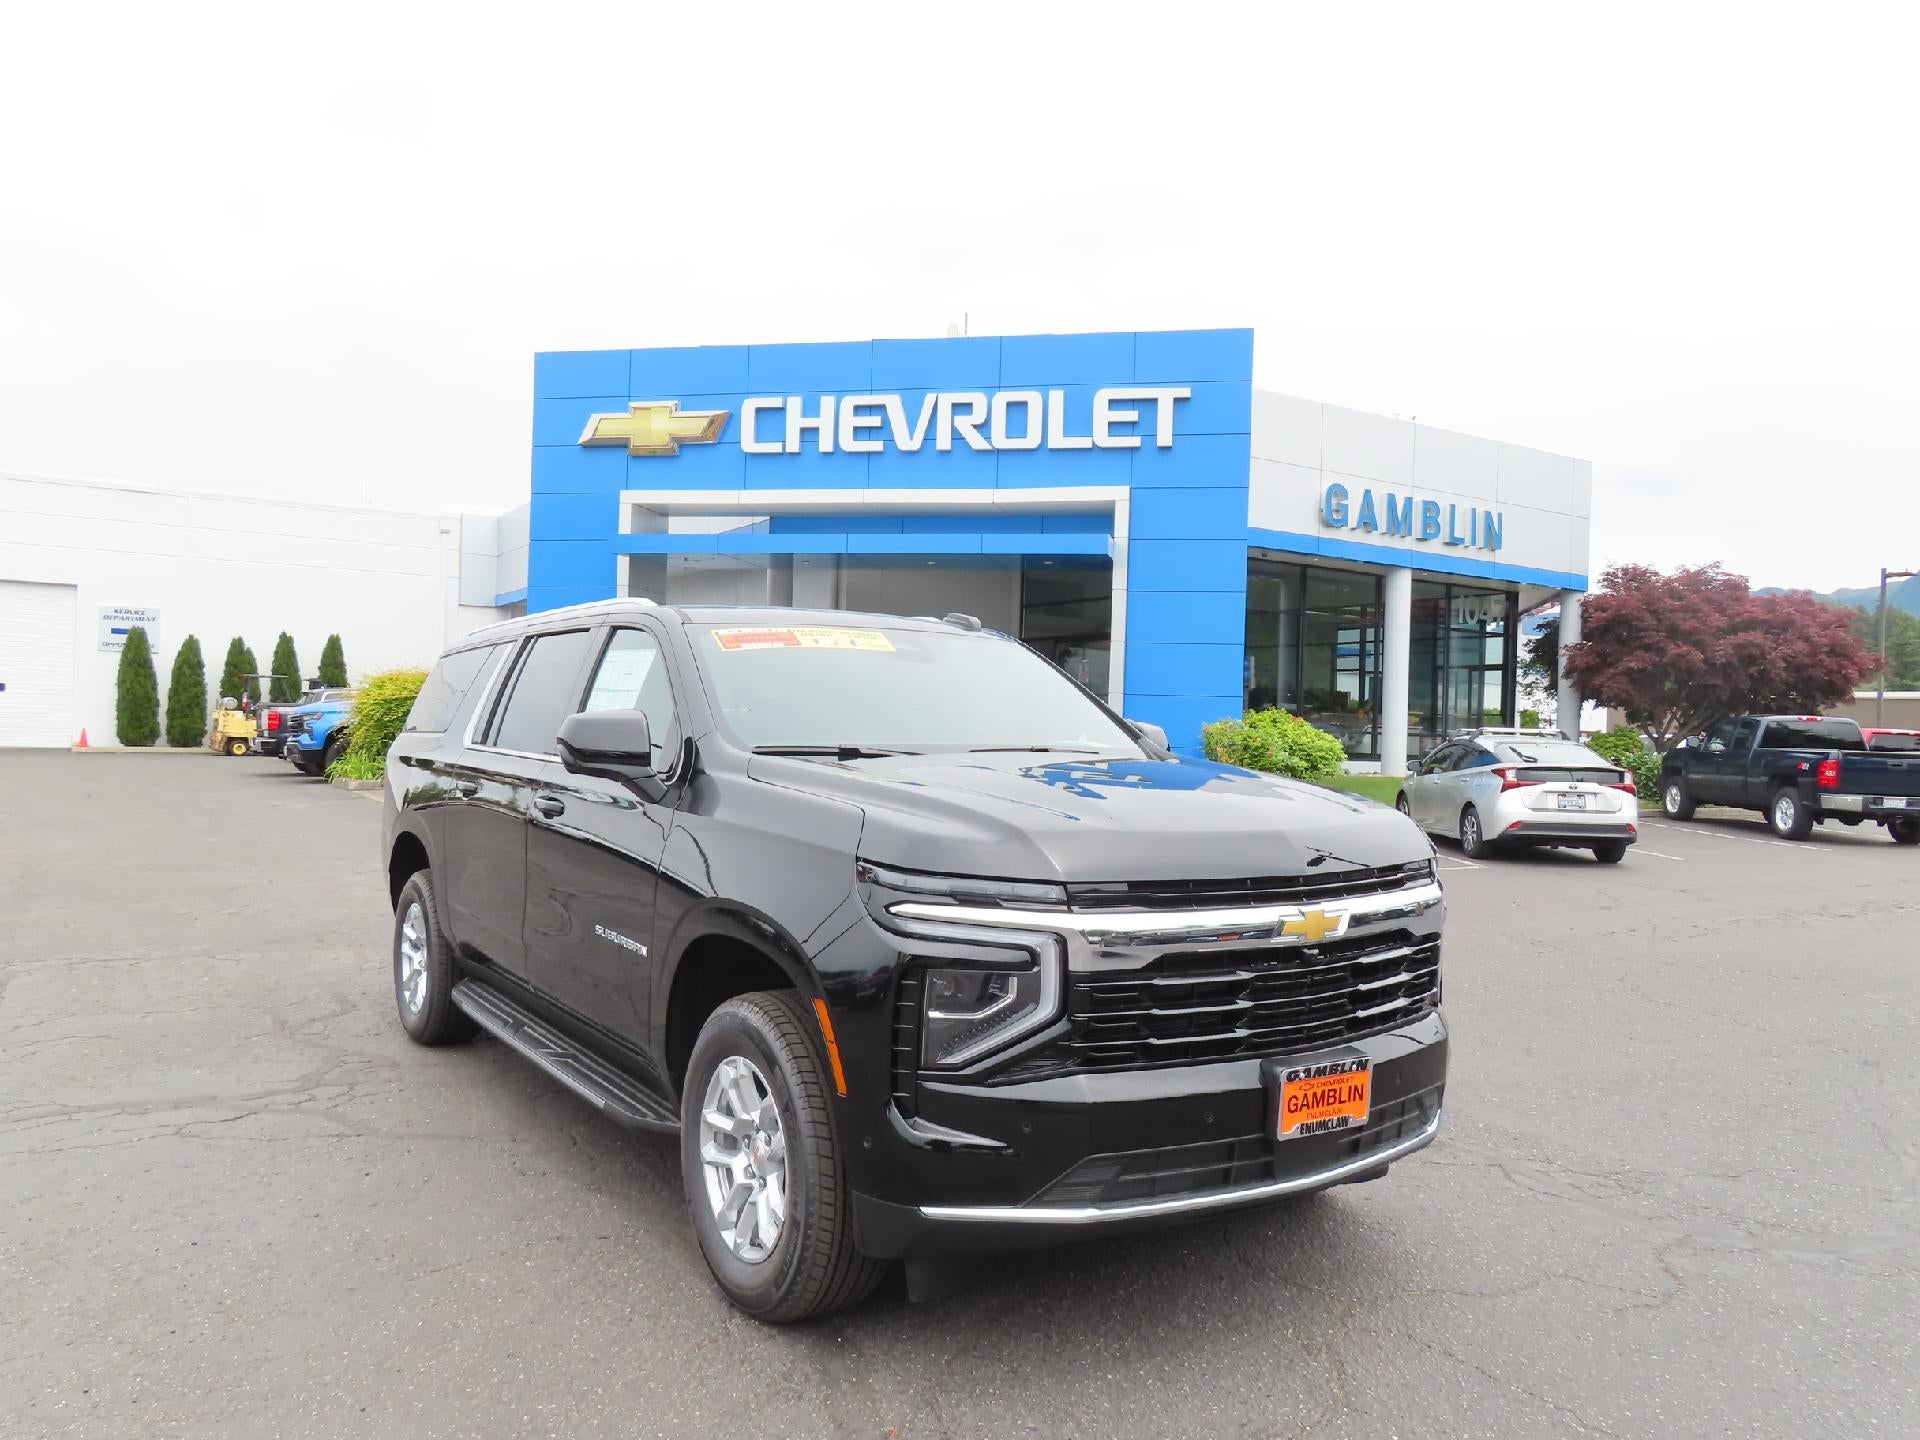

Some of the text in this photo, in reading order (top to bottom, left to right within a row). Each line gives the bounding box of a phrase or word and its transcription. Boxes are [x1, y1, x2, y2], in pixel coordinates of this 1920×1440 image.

[739, 386, 1192, 455] CHEVROLET
[1321, 482, 1503, 551] GAMBLIN
[102, 614, 156, 622] DEPARTMENT
[113, 608, 145, 616] SERVICE
[594, 924, 648, 958] SUBURBAN
[1286, 1058, 1369, 1082] GAMBLIN
[1316, 1076, 1354, 1088] CHEVROLET
[1287, 1084, 1364, 1113] GAMBLIN
[1306, 1107, 1343, 1120] ENUMCLAW
[1299, 1116, 1350, 1135] ENUMCLAW
